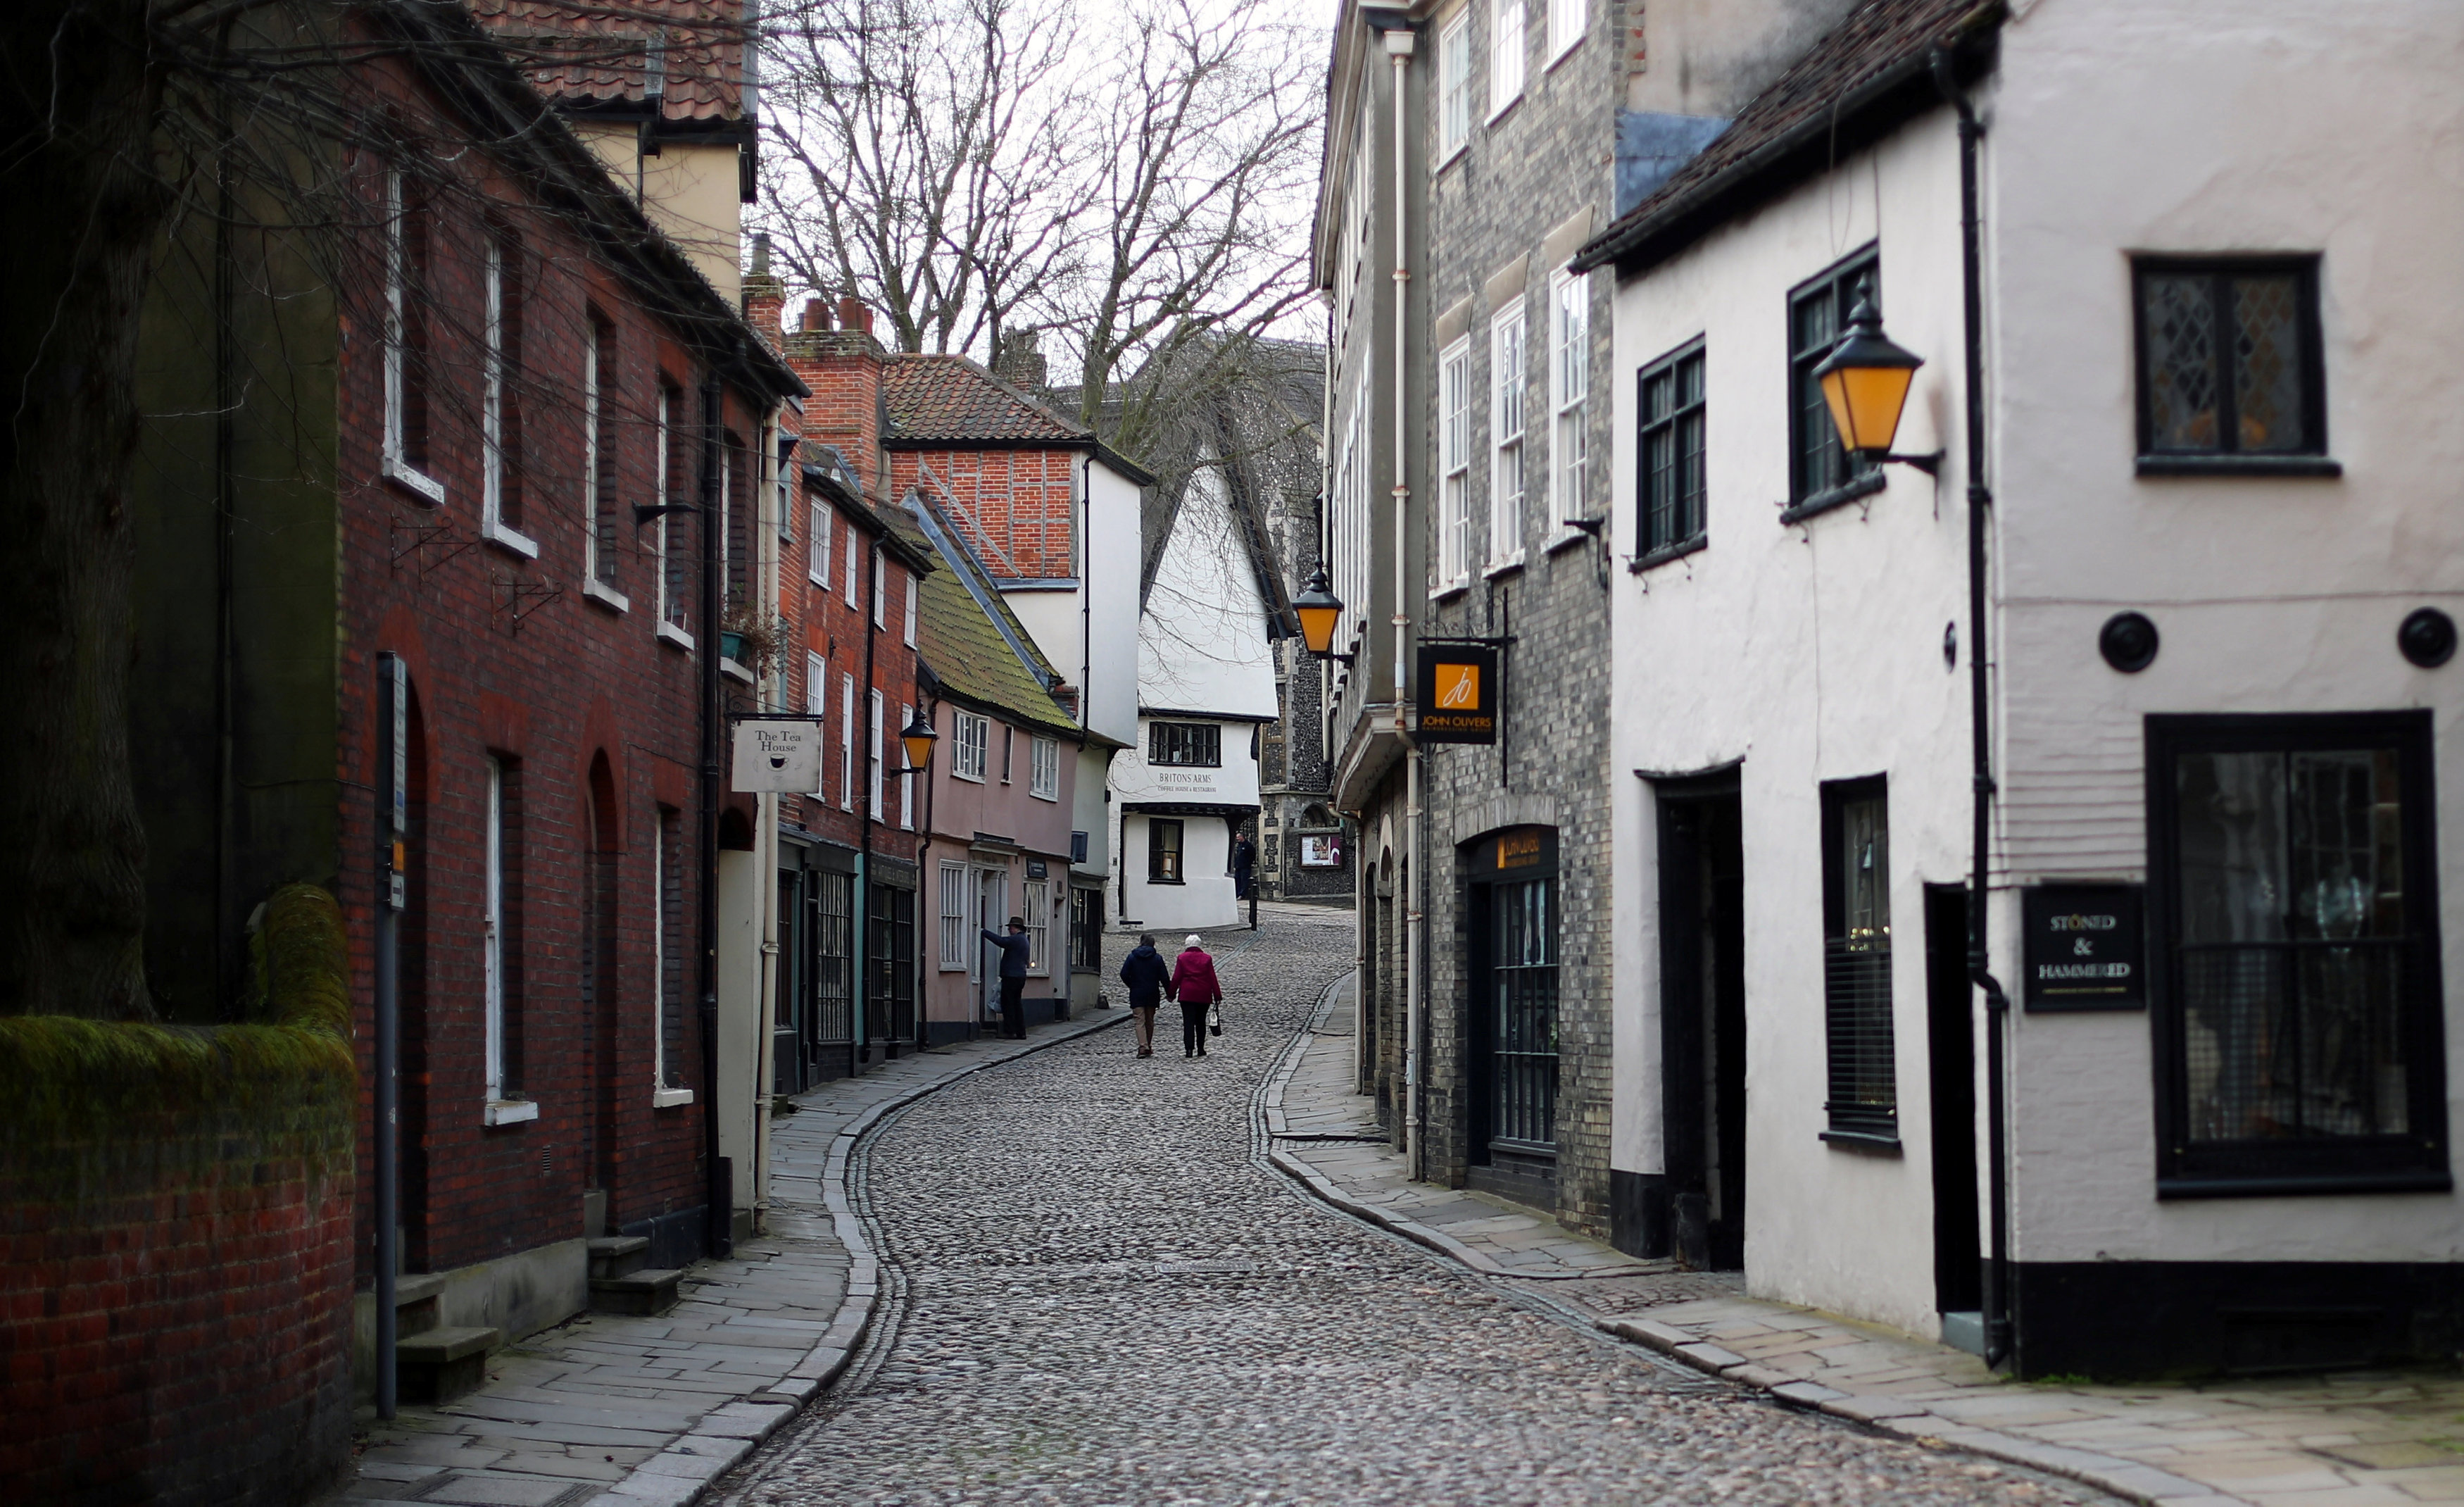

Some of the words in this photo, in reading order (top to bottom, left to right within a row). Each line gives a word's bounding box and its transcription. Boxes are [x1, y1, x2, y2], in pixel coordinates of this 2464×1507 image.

[1421, 715, 1450, 726] JOHN
[1452, 716, 1492, 727] OLIVERS
[755, 730, 778, 741] The
[780, 730, 801, 742] Tea
[761, 742, 797, 752] House
[1159, 773, 1191, 783] BRITONS
[1193, 773, 1212, 783] ARMS
[2050, 913, 2116, 932] STONED
[2073, 937, 2094, 956] &
[2039, 962, 2131, 980] HAMMERED
